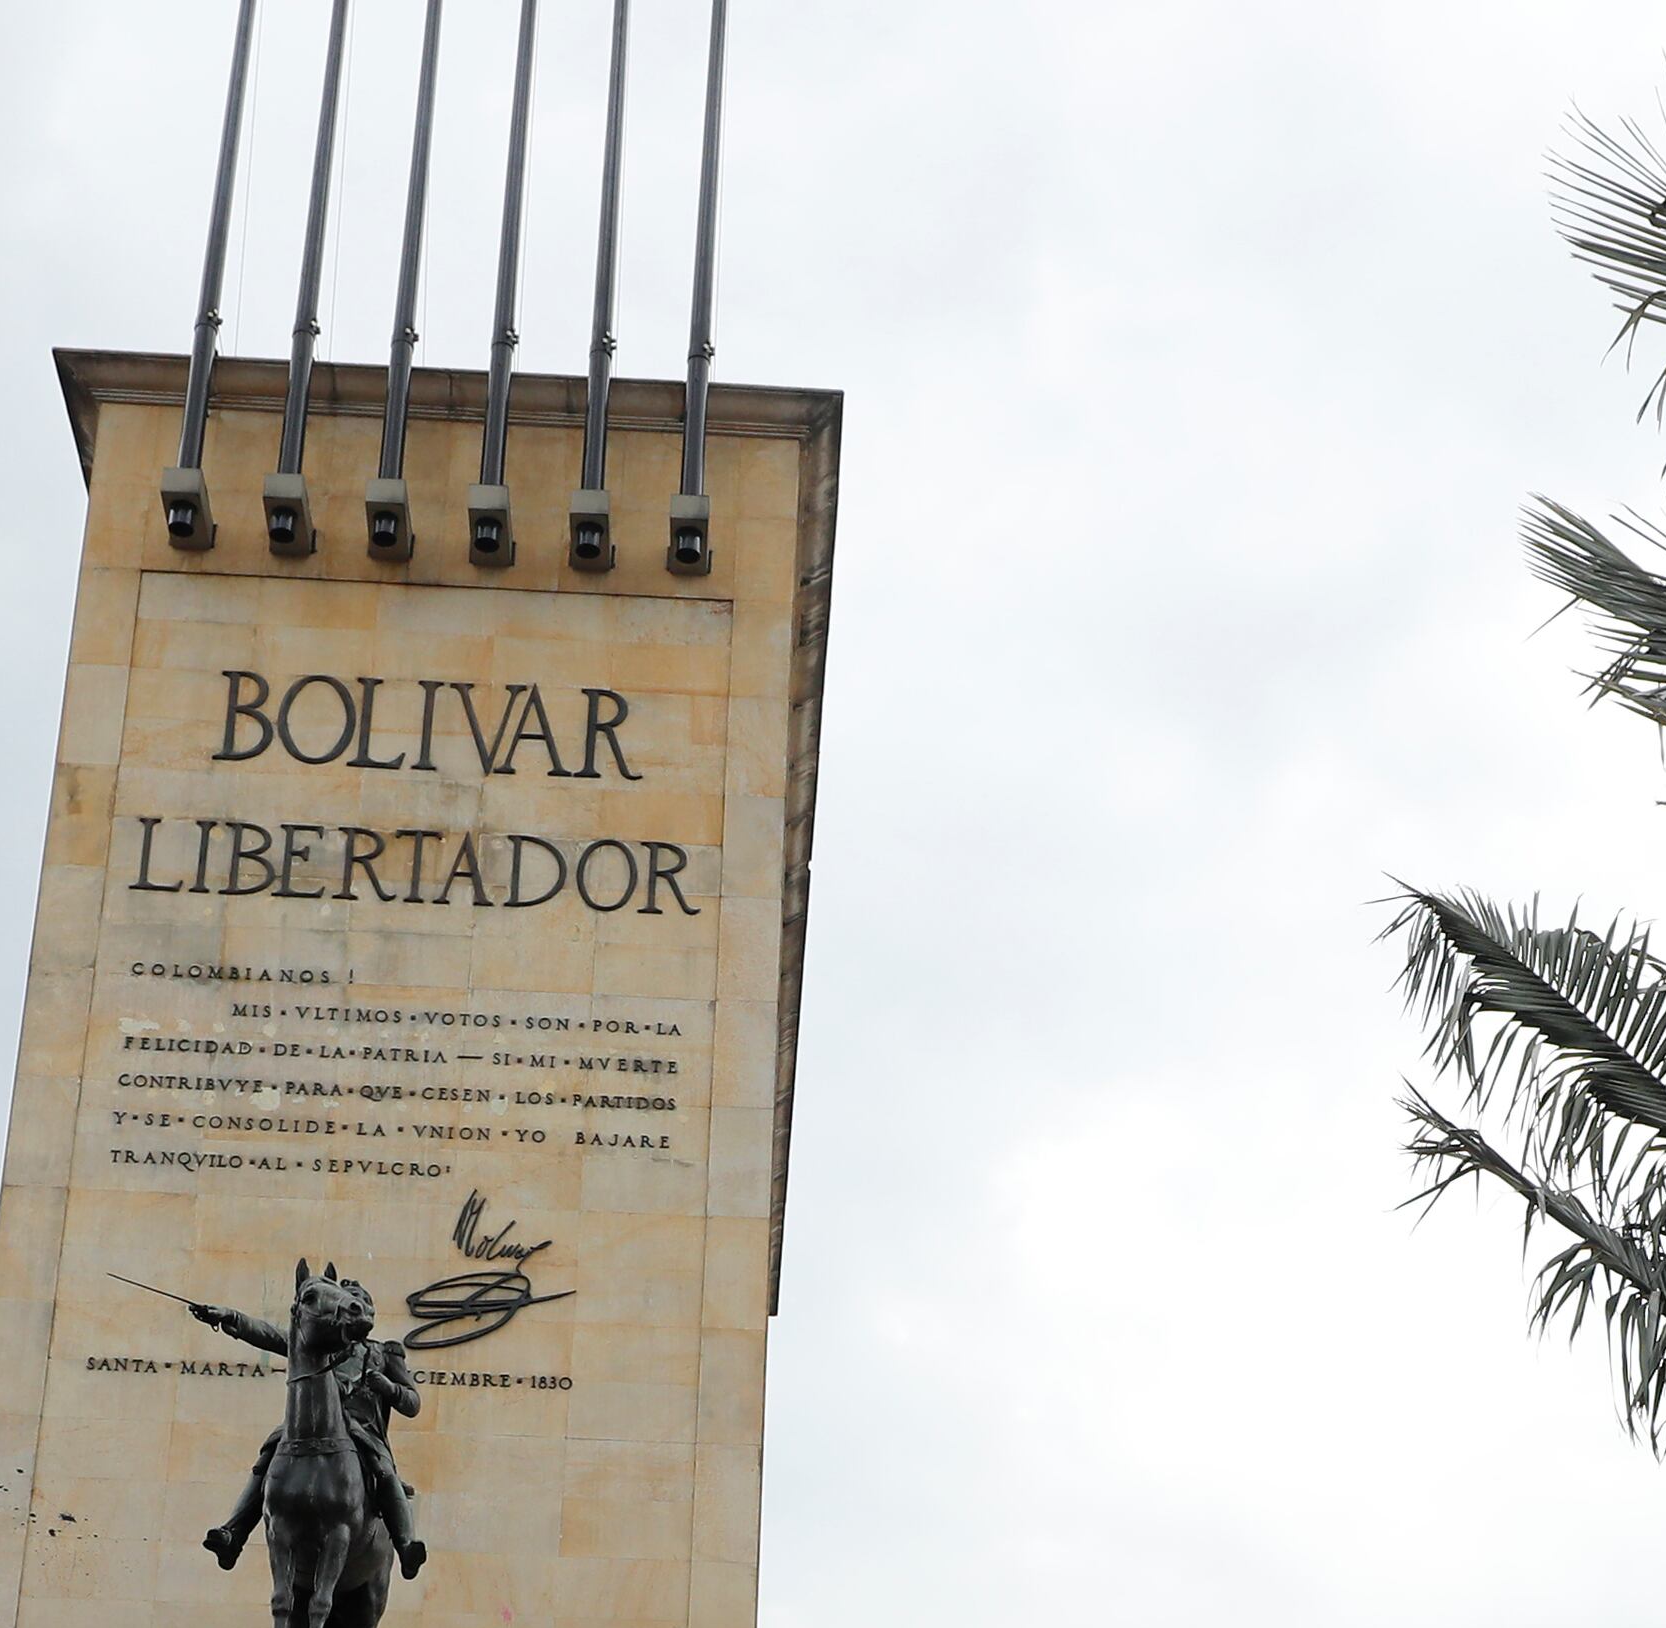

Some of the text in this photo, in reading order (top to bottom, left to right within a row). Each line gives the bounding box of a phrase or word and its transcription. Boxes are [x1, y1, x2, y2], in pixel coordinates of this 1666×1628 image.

[212, 669, 643, 781] BOLIVAR
[129, 817, 702, 915] LIBERTADOR
[131, 963, 331, 983] COLOMBIANOS
[232, 1004, 682, 1037] MIS VLTIMOS VOTOS SON POR LA
[123, 1036, 678, 1074] FELICIDAD DE LA PATRIA SI MI MVERTE
[118, 1074, 677, 1111] CONTRIBVYE PARA QVE CESEN LOS PARTIDOS
[113, 1112, 670, 1149] Y SE CONSOLIDE LA VNION YO BAJARE
[110, 1150, 243, 1172] TRANQVILO
[258, 1157, 287, 1171] AL
[86, 1357, 573, 1390] SANTA MARTA CIEMBRE 1830
